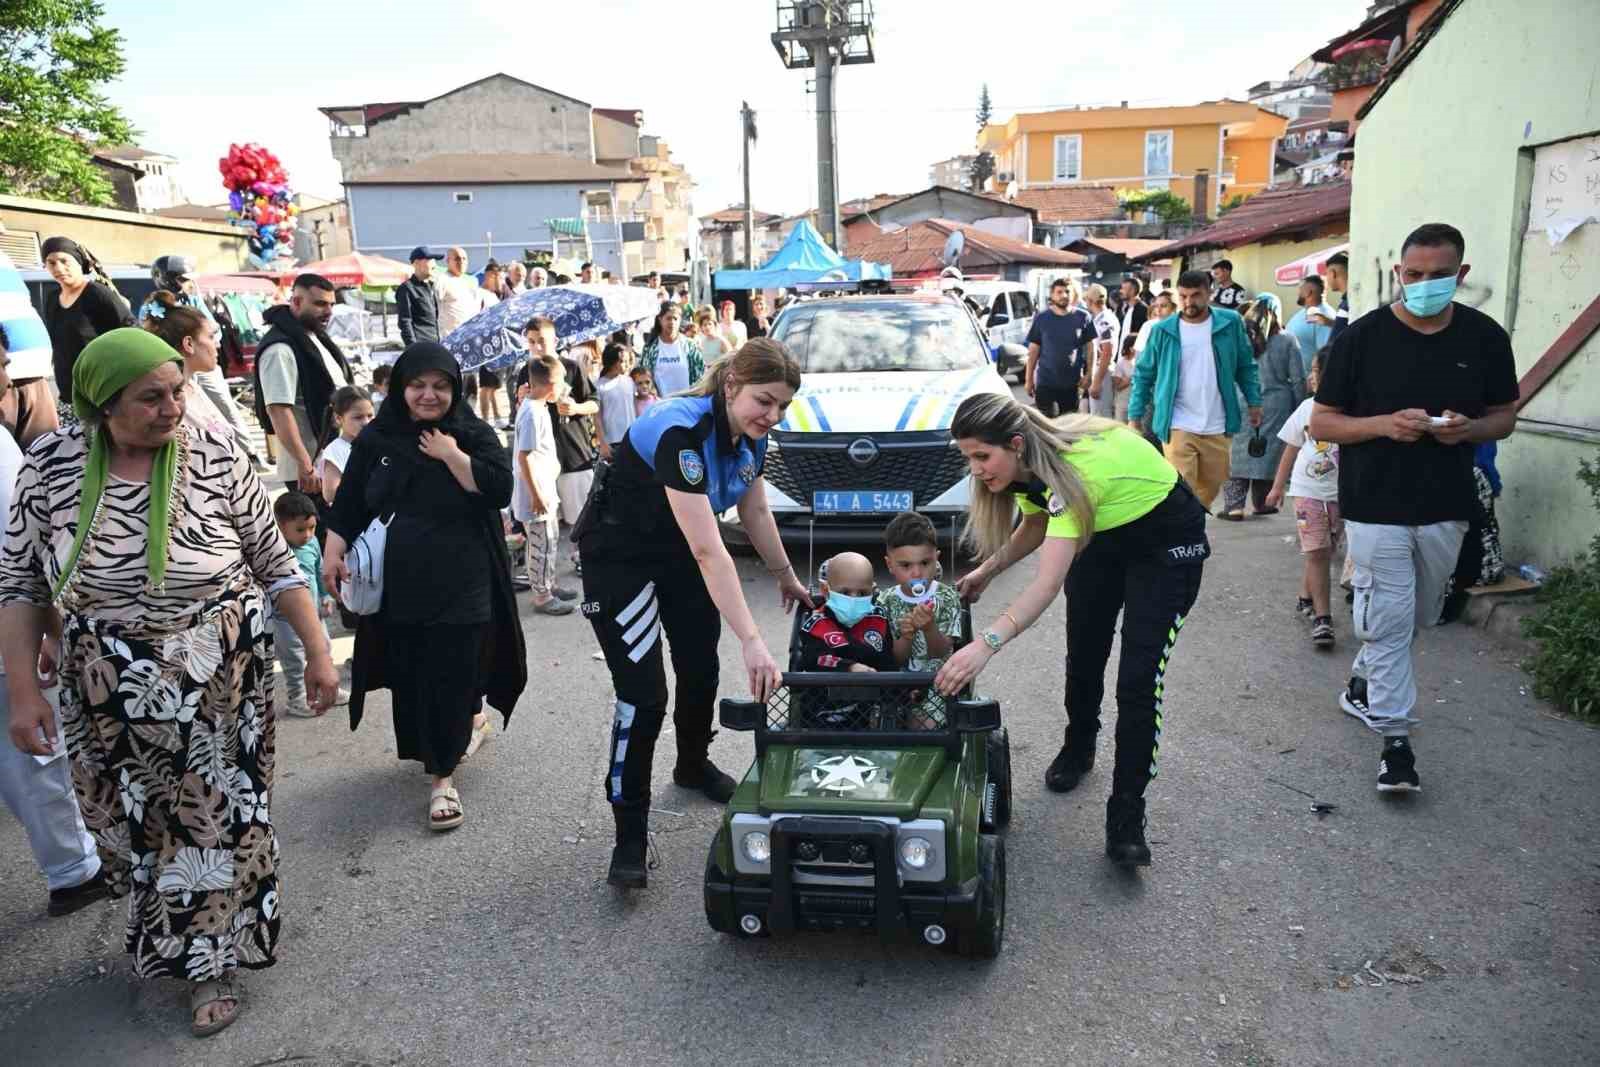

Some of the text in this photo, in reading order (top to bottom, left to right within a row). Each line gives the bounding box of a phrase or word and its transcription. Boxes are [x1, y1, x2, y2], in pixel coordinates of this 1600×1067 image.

[824, 493, 839, 509] 41
[852, 493, 860, 509] A
[873, 493, 911, 509] 5443
